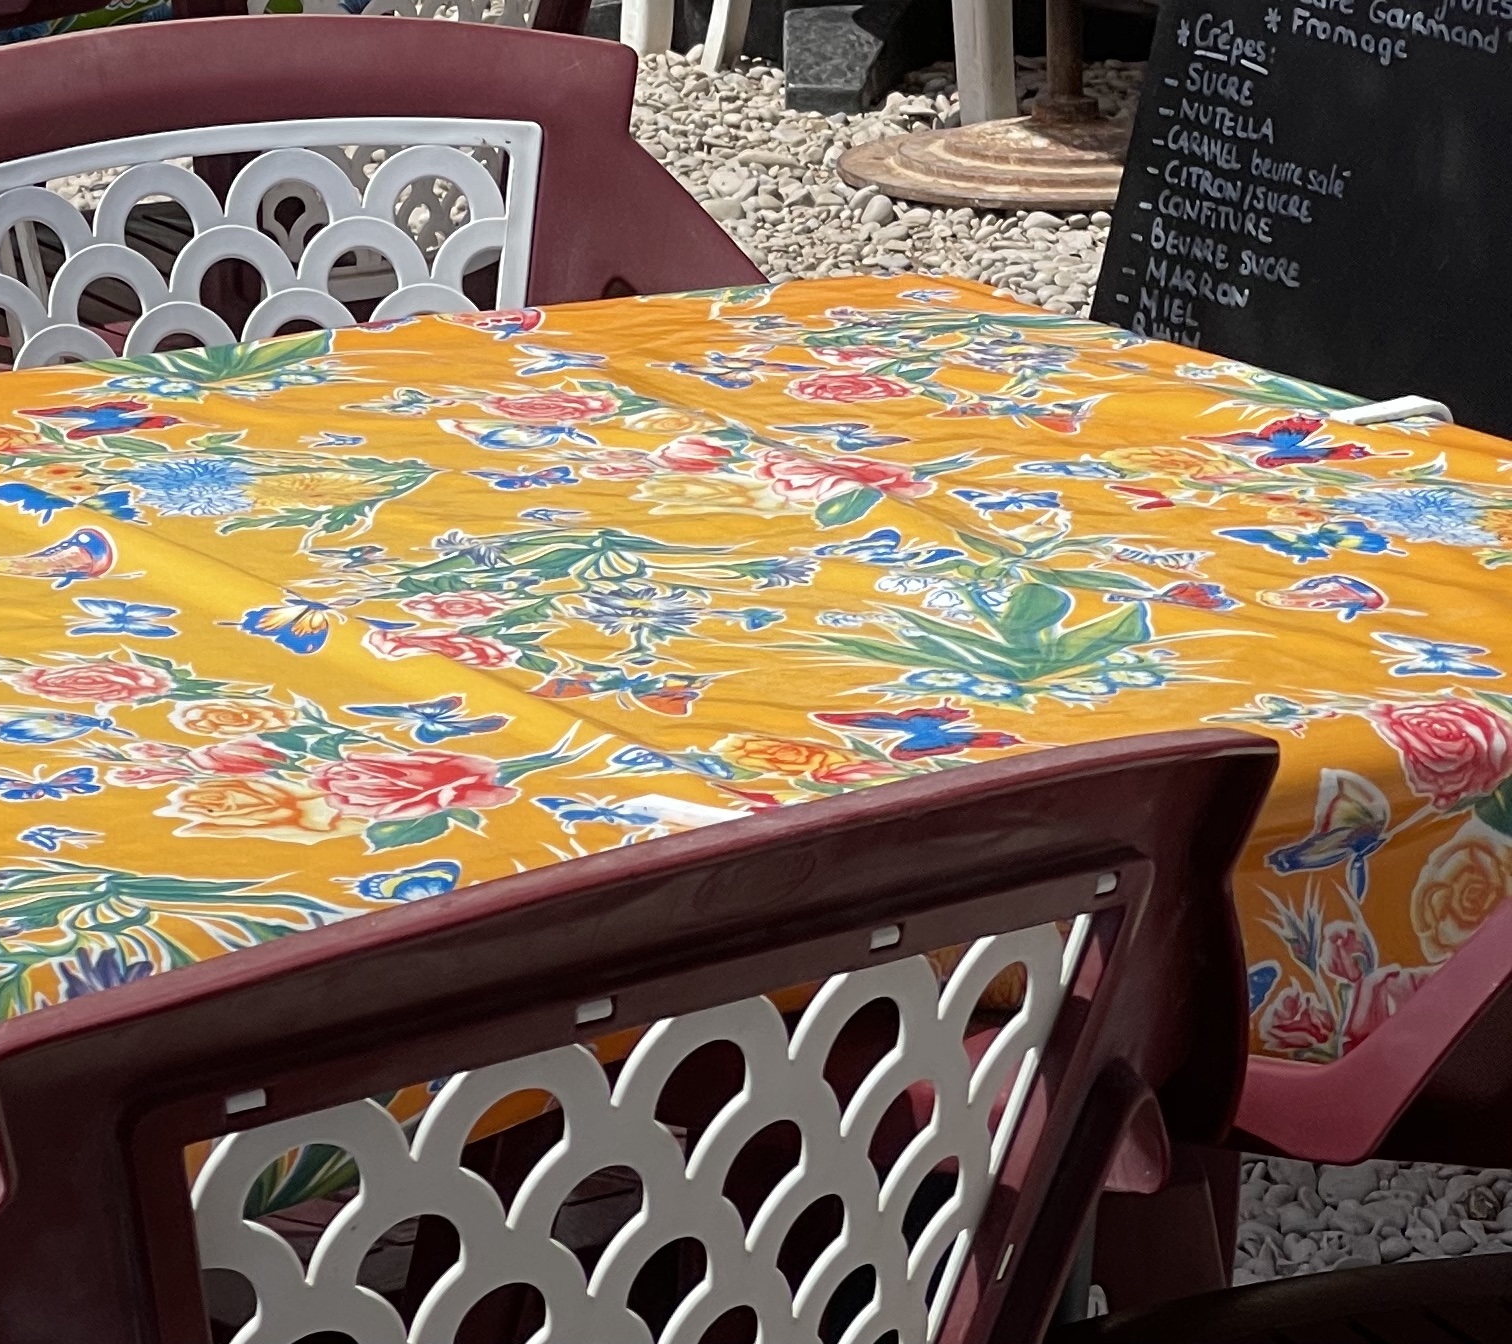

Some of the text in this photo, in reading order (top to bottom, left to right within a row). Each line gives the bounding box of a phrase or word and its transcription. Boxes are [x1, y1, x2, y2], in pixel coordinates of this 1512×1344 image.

[1292, 7, 1407, 66] Fromage
[1186, 62, 1254, 106] SUCRE
[1179, 97, 1274, 144] NUTELLA
[1167, 124, 1241, 169] CARAMEL
[1251, 148, 1303, 186] beurre
[1145, 256, 1250, 308] MARRON
[1239, 249, 1301, 288] SUCRE
[1140, 286, 1199, 327] MIEL
